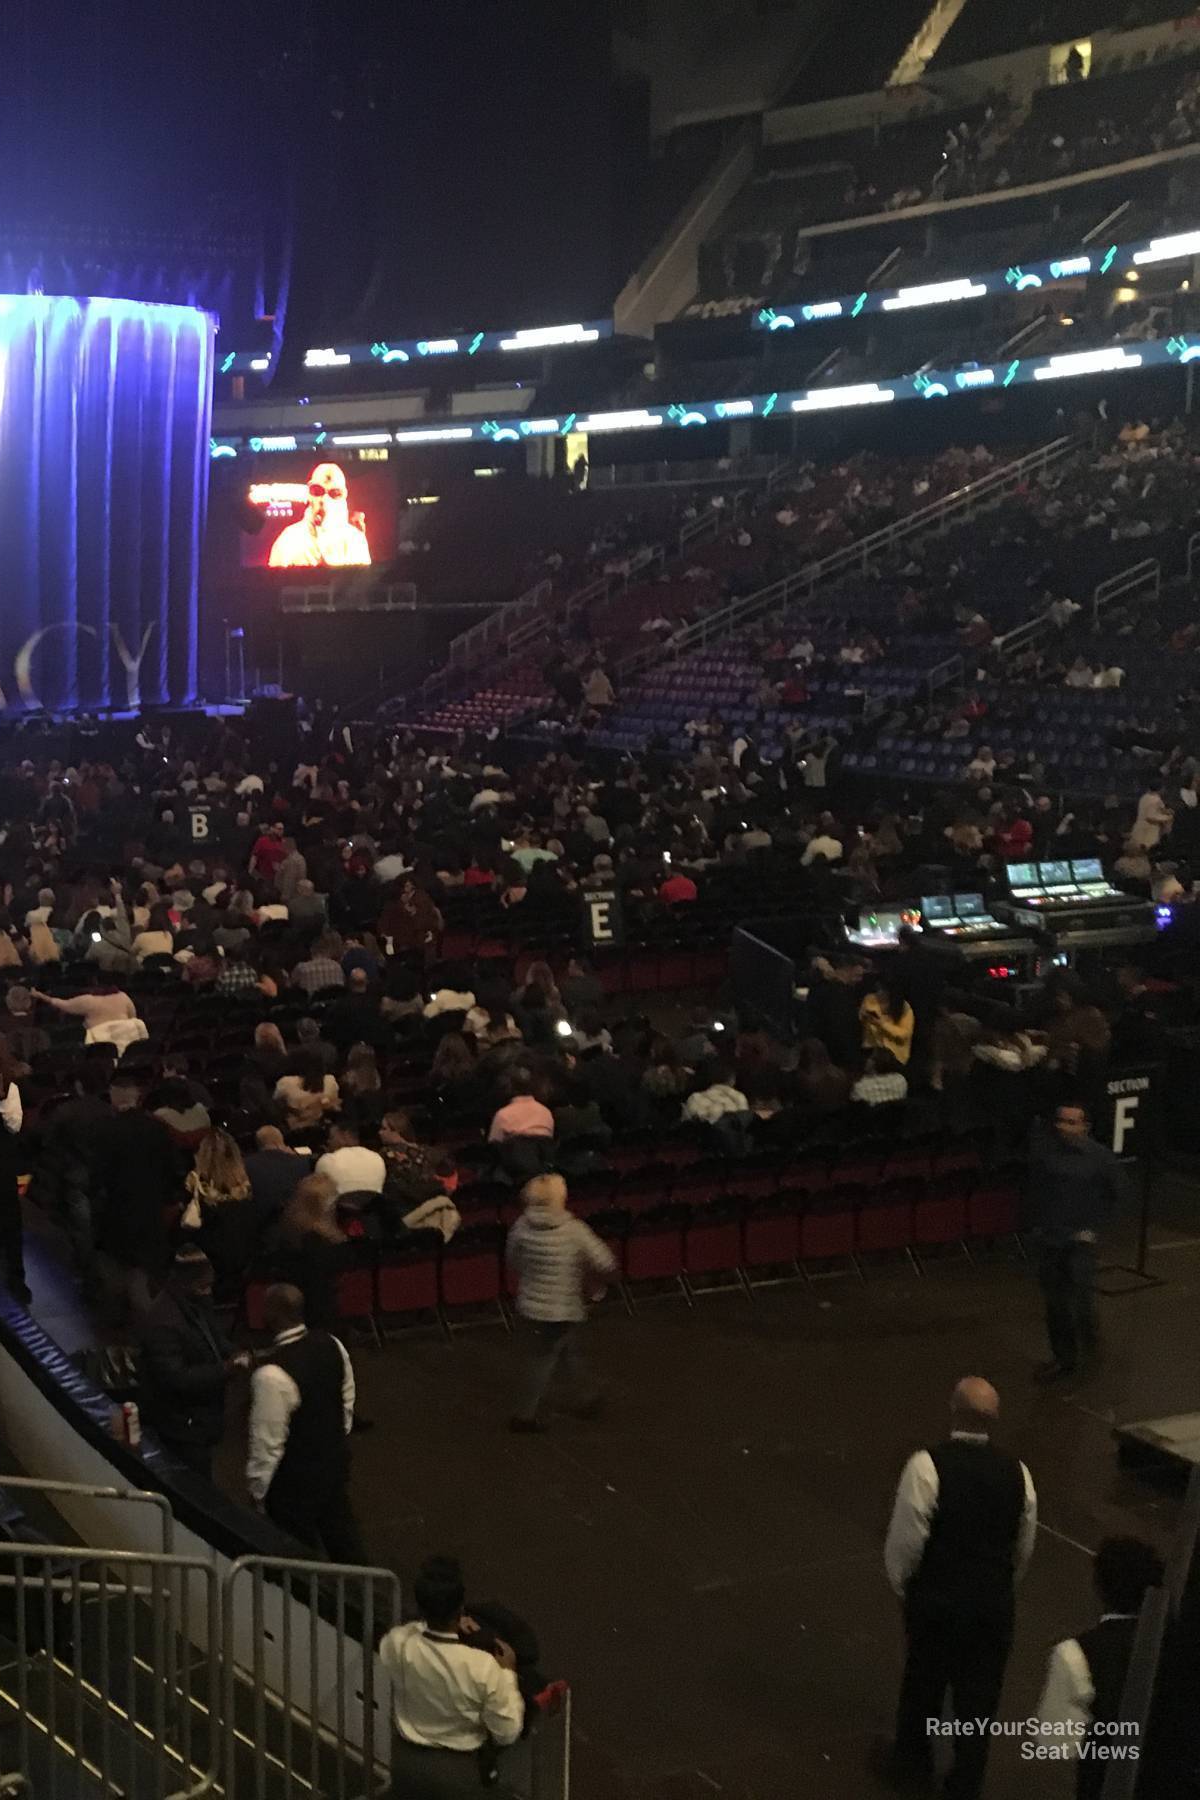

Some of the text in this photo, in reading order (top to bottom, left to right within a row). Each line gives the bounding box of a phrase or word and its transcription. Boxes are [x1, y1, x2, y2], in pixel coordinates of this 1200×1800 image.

[192, 813, 209, 838] B
[590, 902, 613, 938] E
[1107, 1076, 1150, 1095] SECTION
[1112, 1096, 1139, 1153] F
